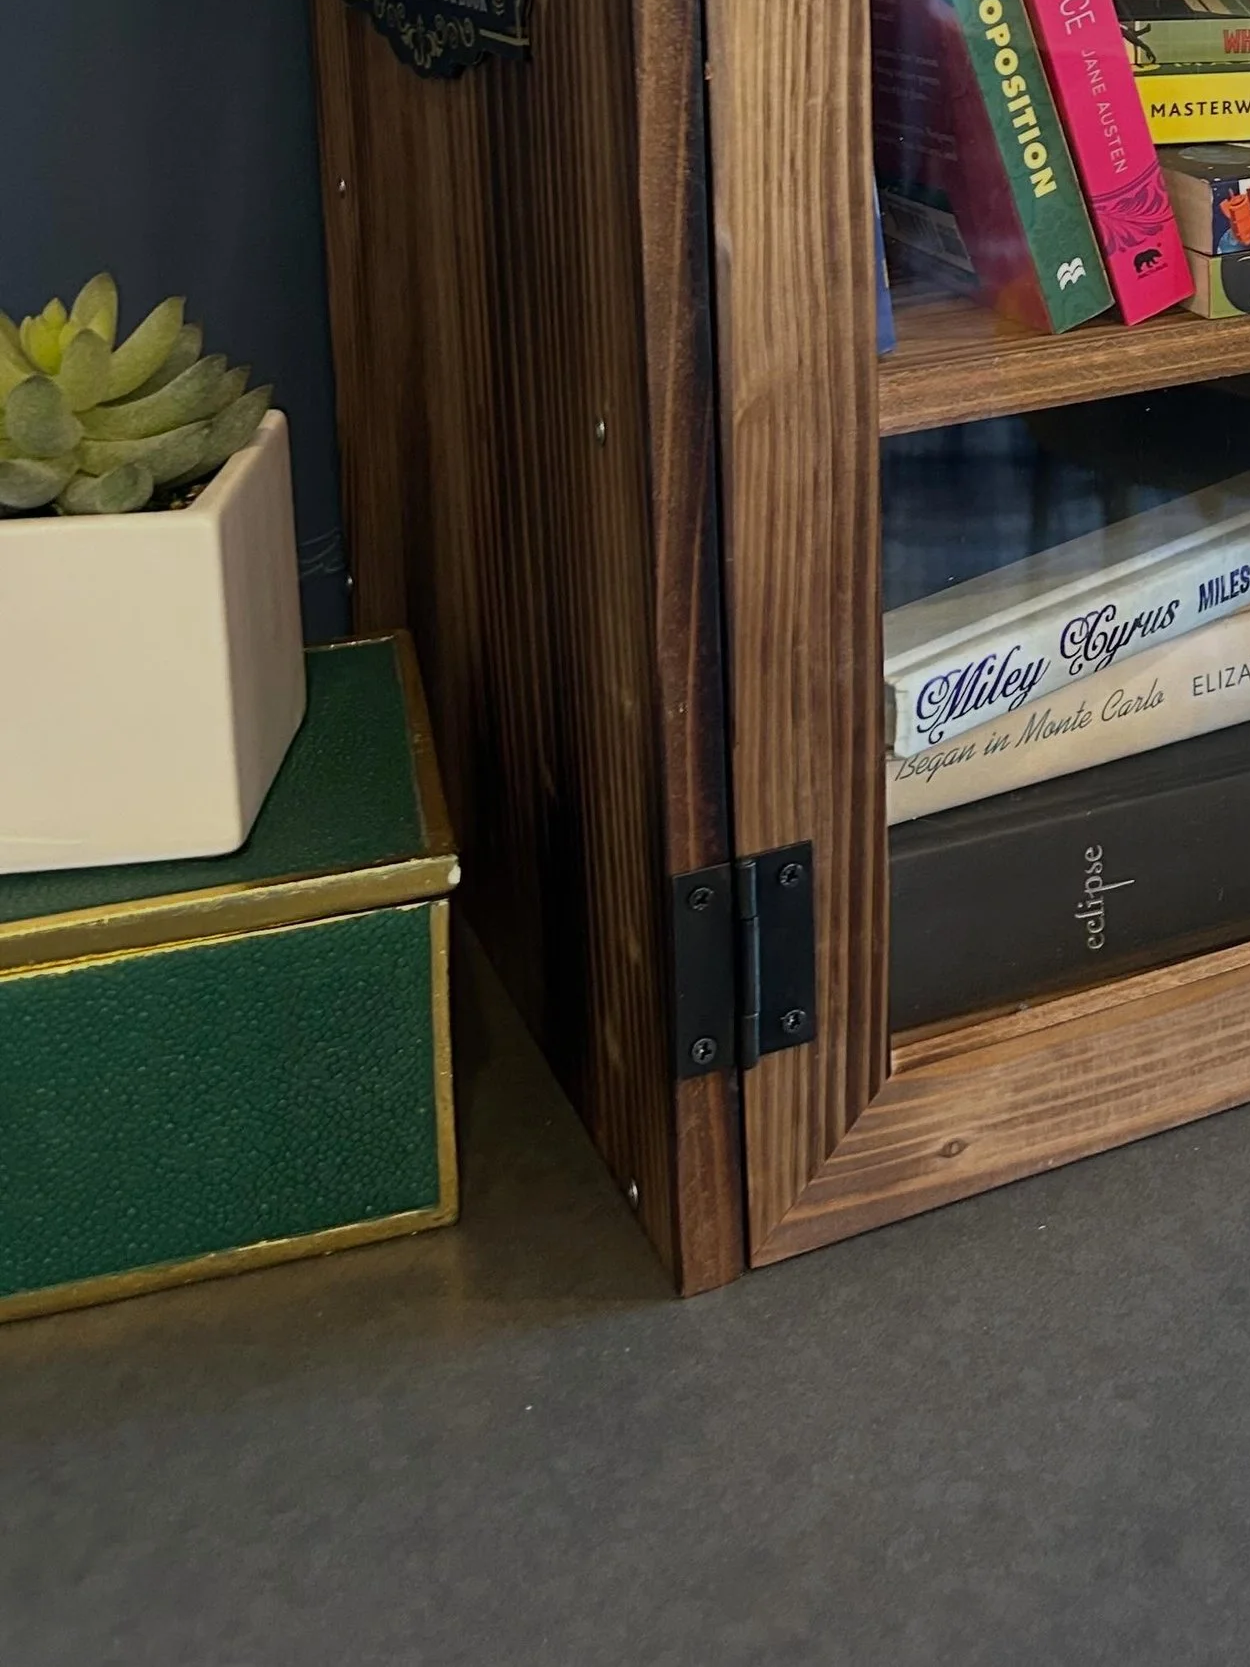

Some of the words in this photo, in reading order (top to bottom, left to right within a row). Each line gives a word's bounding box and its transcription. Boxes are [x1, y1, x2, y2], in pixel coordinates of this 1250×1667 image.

[1081, 48, 1107, 97] JANE
[1096, 100, 1128, 175] AUSTEN
[894, 742, 977, 784] Began
[983, 732, 1012, 756] in
[1014, 699, 1095, 750] Monte
[1100, 676, 1166, 723] Carlo
[916, 644, 1051, 745] Miley
[1059, 603, 1181, 677] Cyrus
[1073, 843, 1136, 951] eclipse
